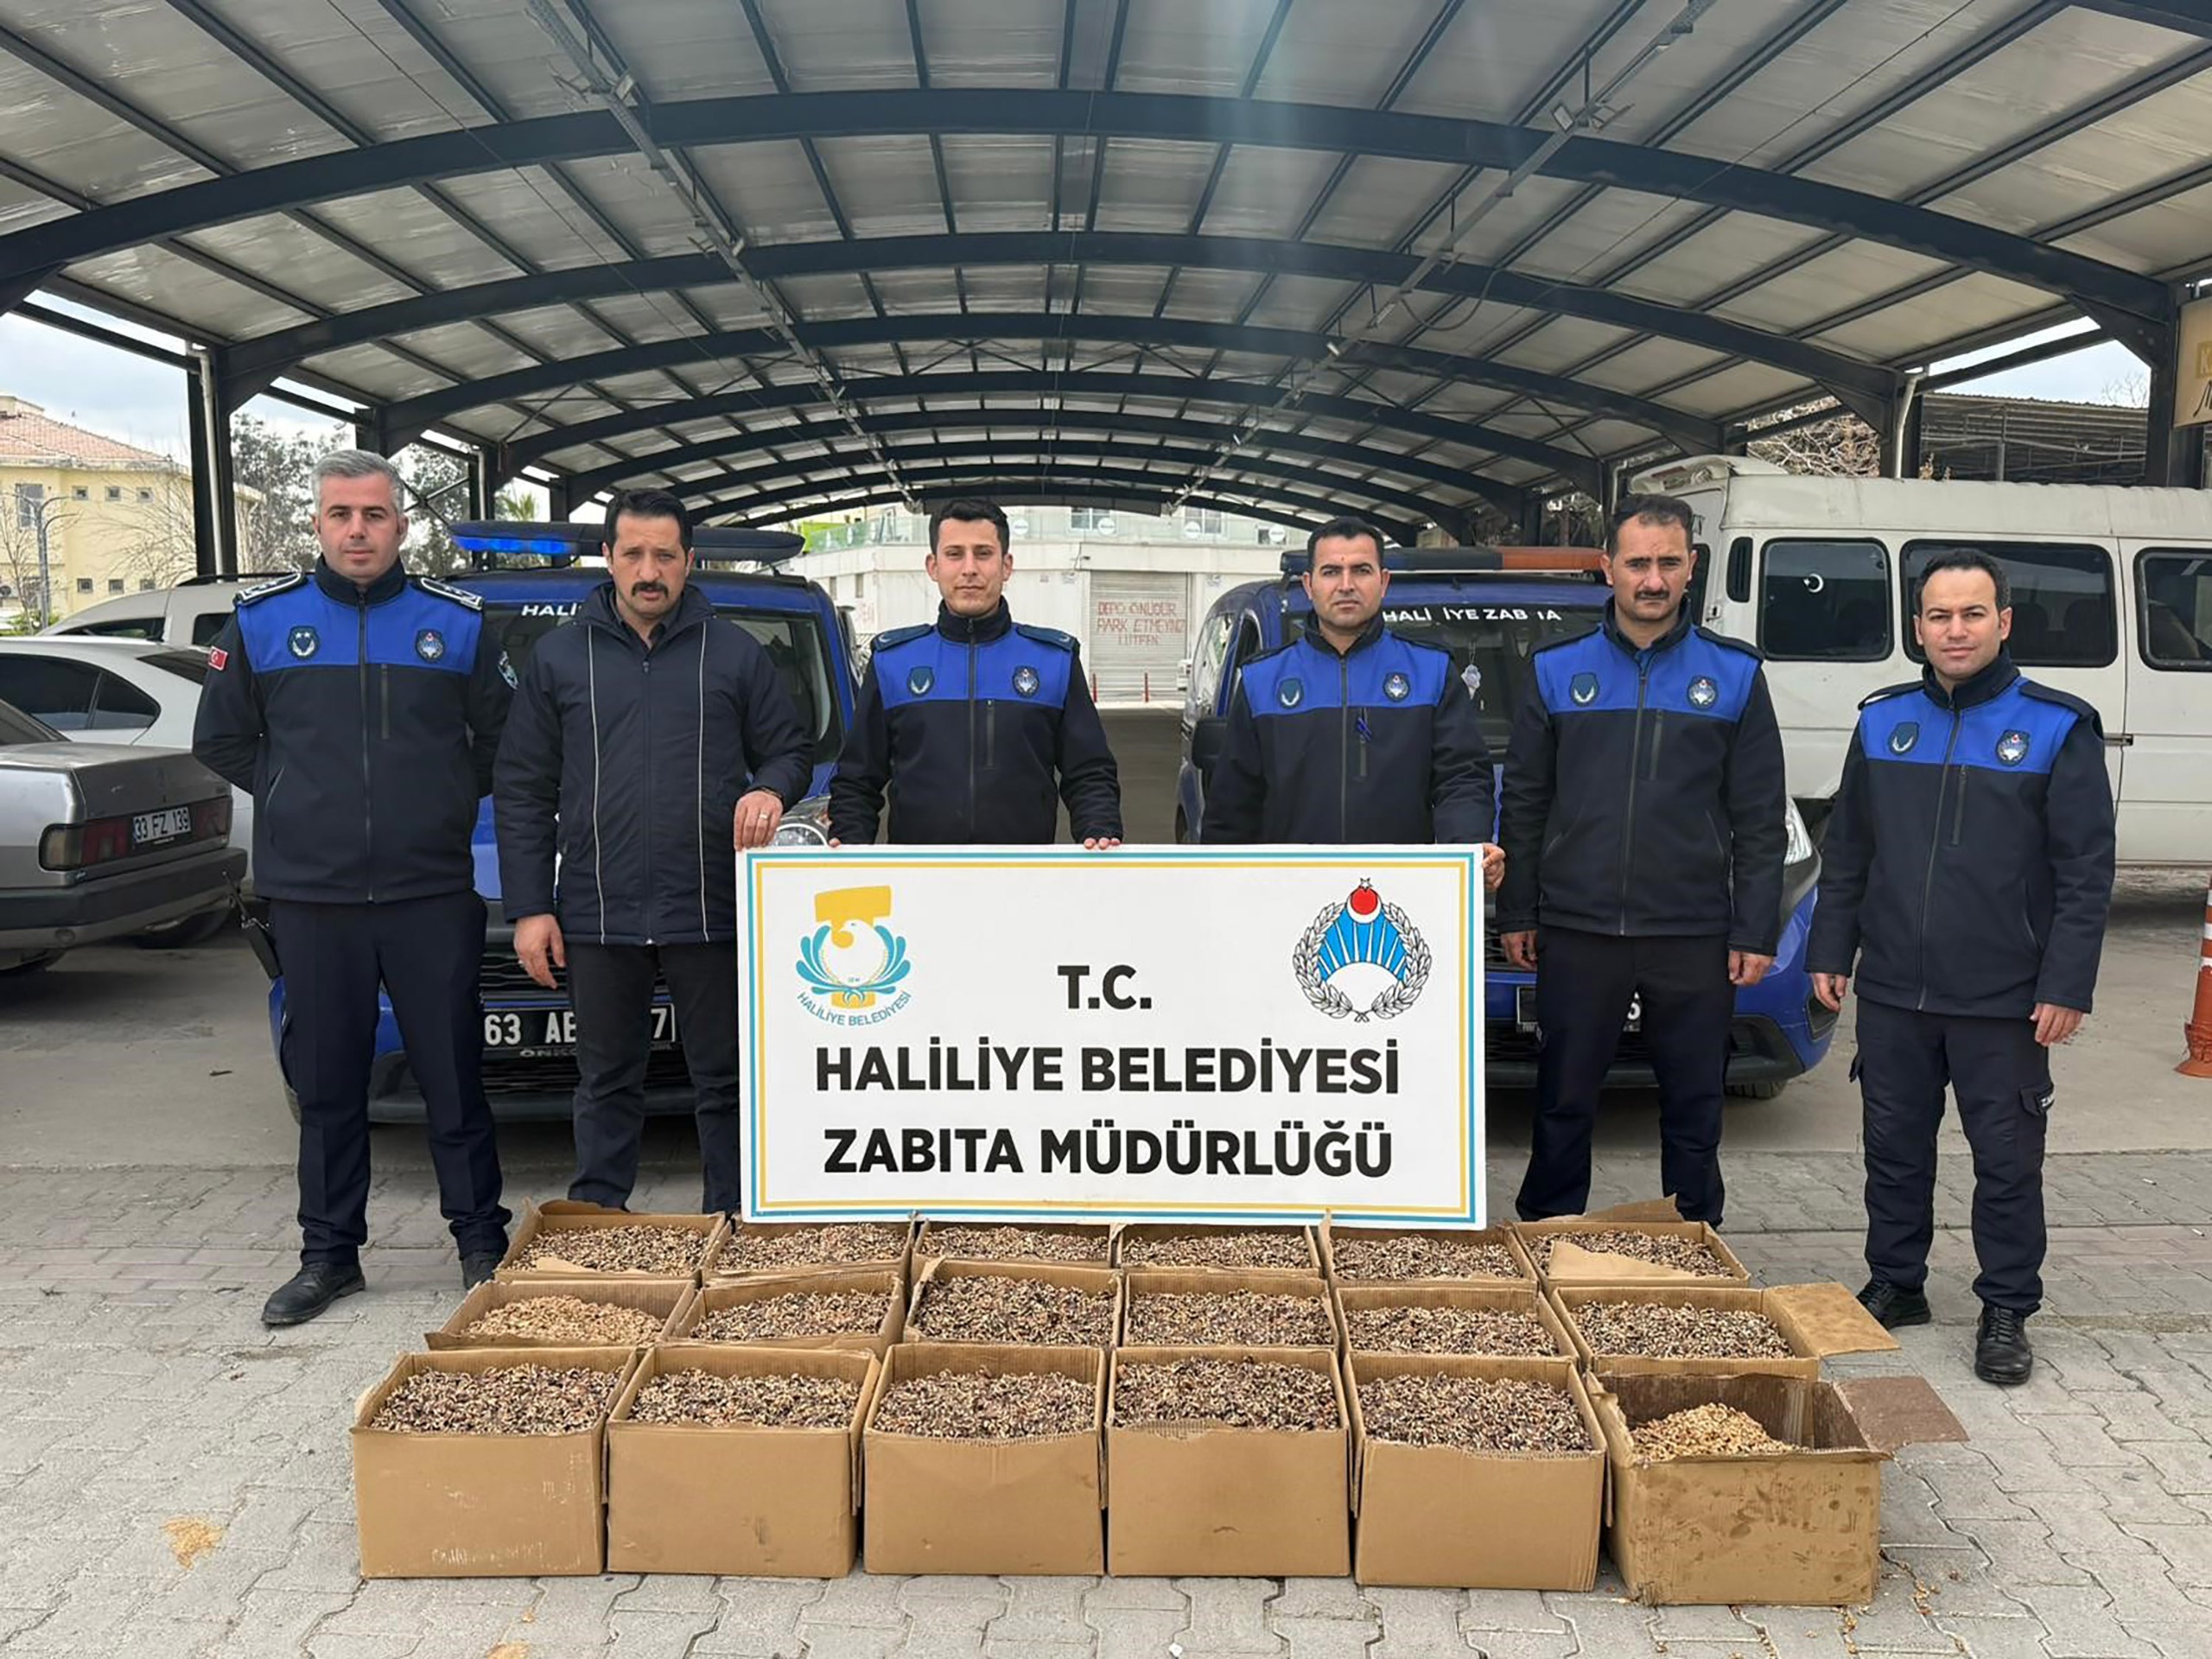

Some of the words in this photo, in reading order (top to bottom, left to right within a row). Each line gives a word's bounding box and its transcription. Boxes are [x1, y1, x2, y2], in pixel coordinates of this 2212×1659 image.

[1097, 618, 1128, 632] PARK
[135, 817, 149, 840] 33
[152, 813, 168, 836] FZ
[1058, 965, 1152, 1009] T.C.
[485, 1014, 521, 1046] 63
[817, 1036, 1063, 1090] HALİLİYE
[1081, 1038, 1398, 1094] BELEDİYESİ
[823, 1128, 1024, 1173] ZABITA
[1040, 1119, 1392, 1178] MÜDÜRLÜĞÜ
